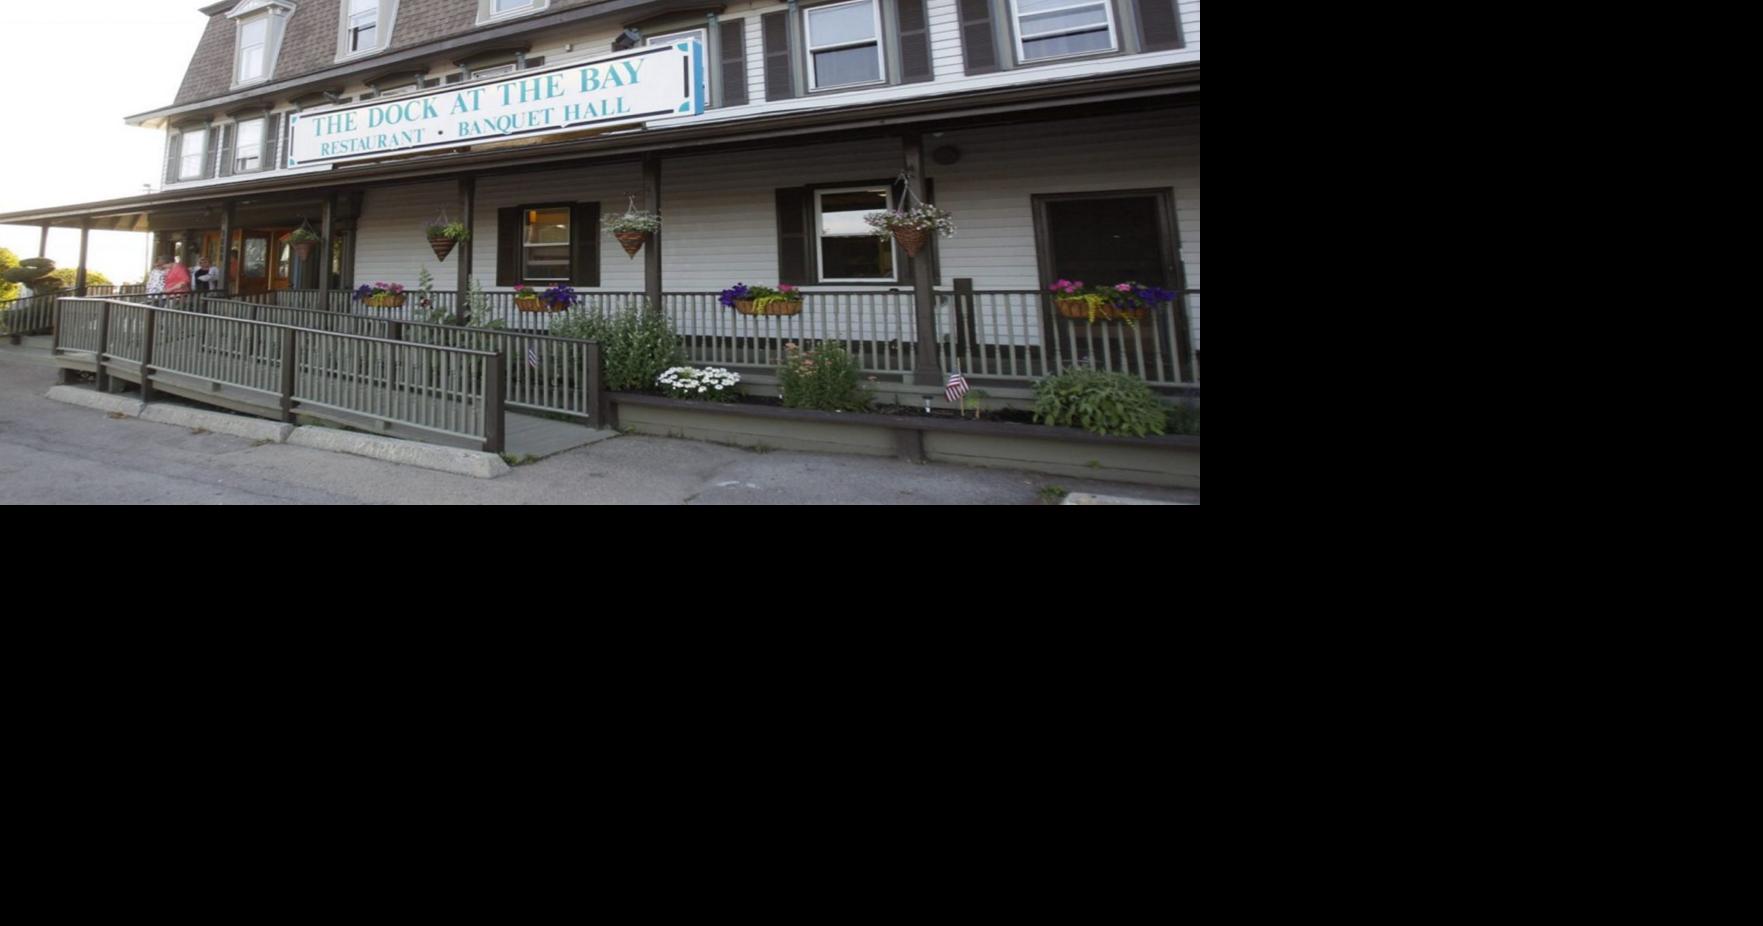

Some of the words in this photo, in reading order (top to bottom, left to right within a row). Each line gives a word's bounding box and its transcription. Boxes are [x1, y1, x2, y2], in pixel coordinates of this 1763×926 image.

[312, 111, 357, 137] THE
[367, 98, 438, 128] DOCK
[450, 88, 486, 116] AT
[497, 73, 565, 106] THE
[579, 59, 645, 93] BAY
[321, 128, 425, 156] RESTAURANT
[458, 107, 555, 135] BANQUET
[563, 96, 631, 121] HALL
